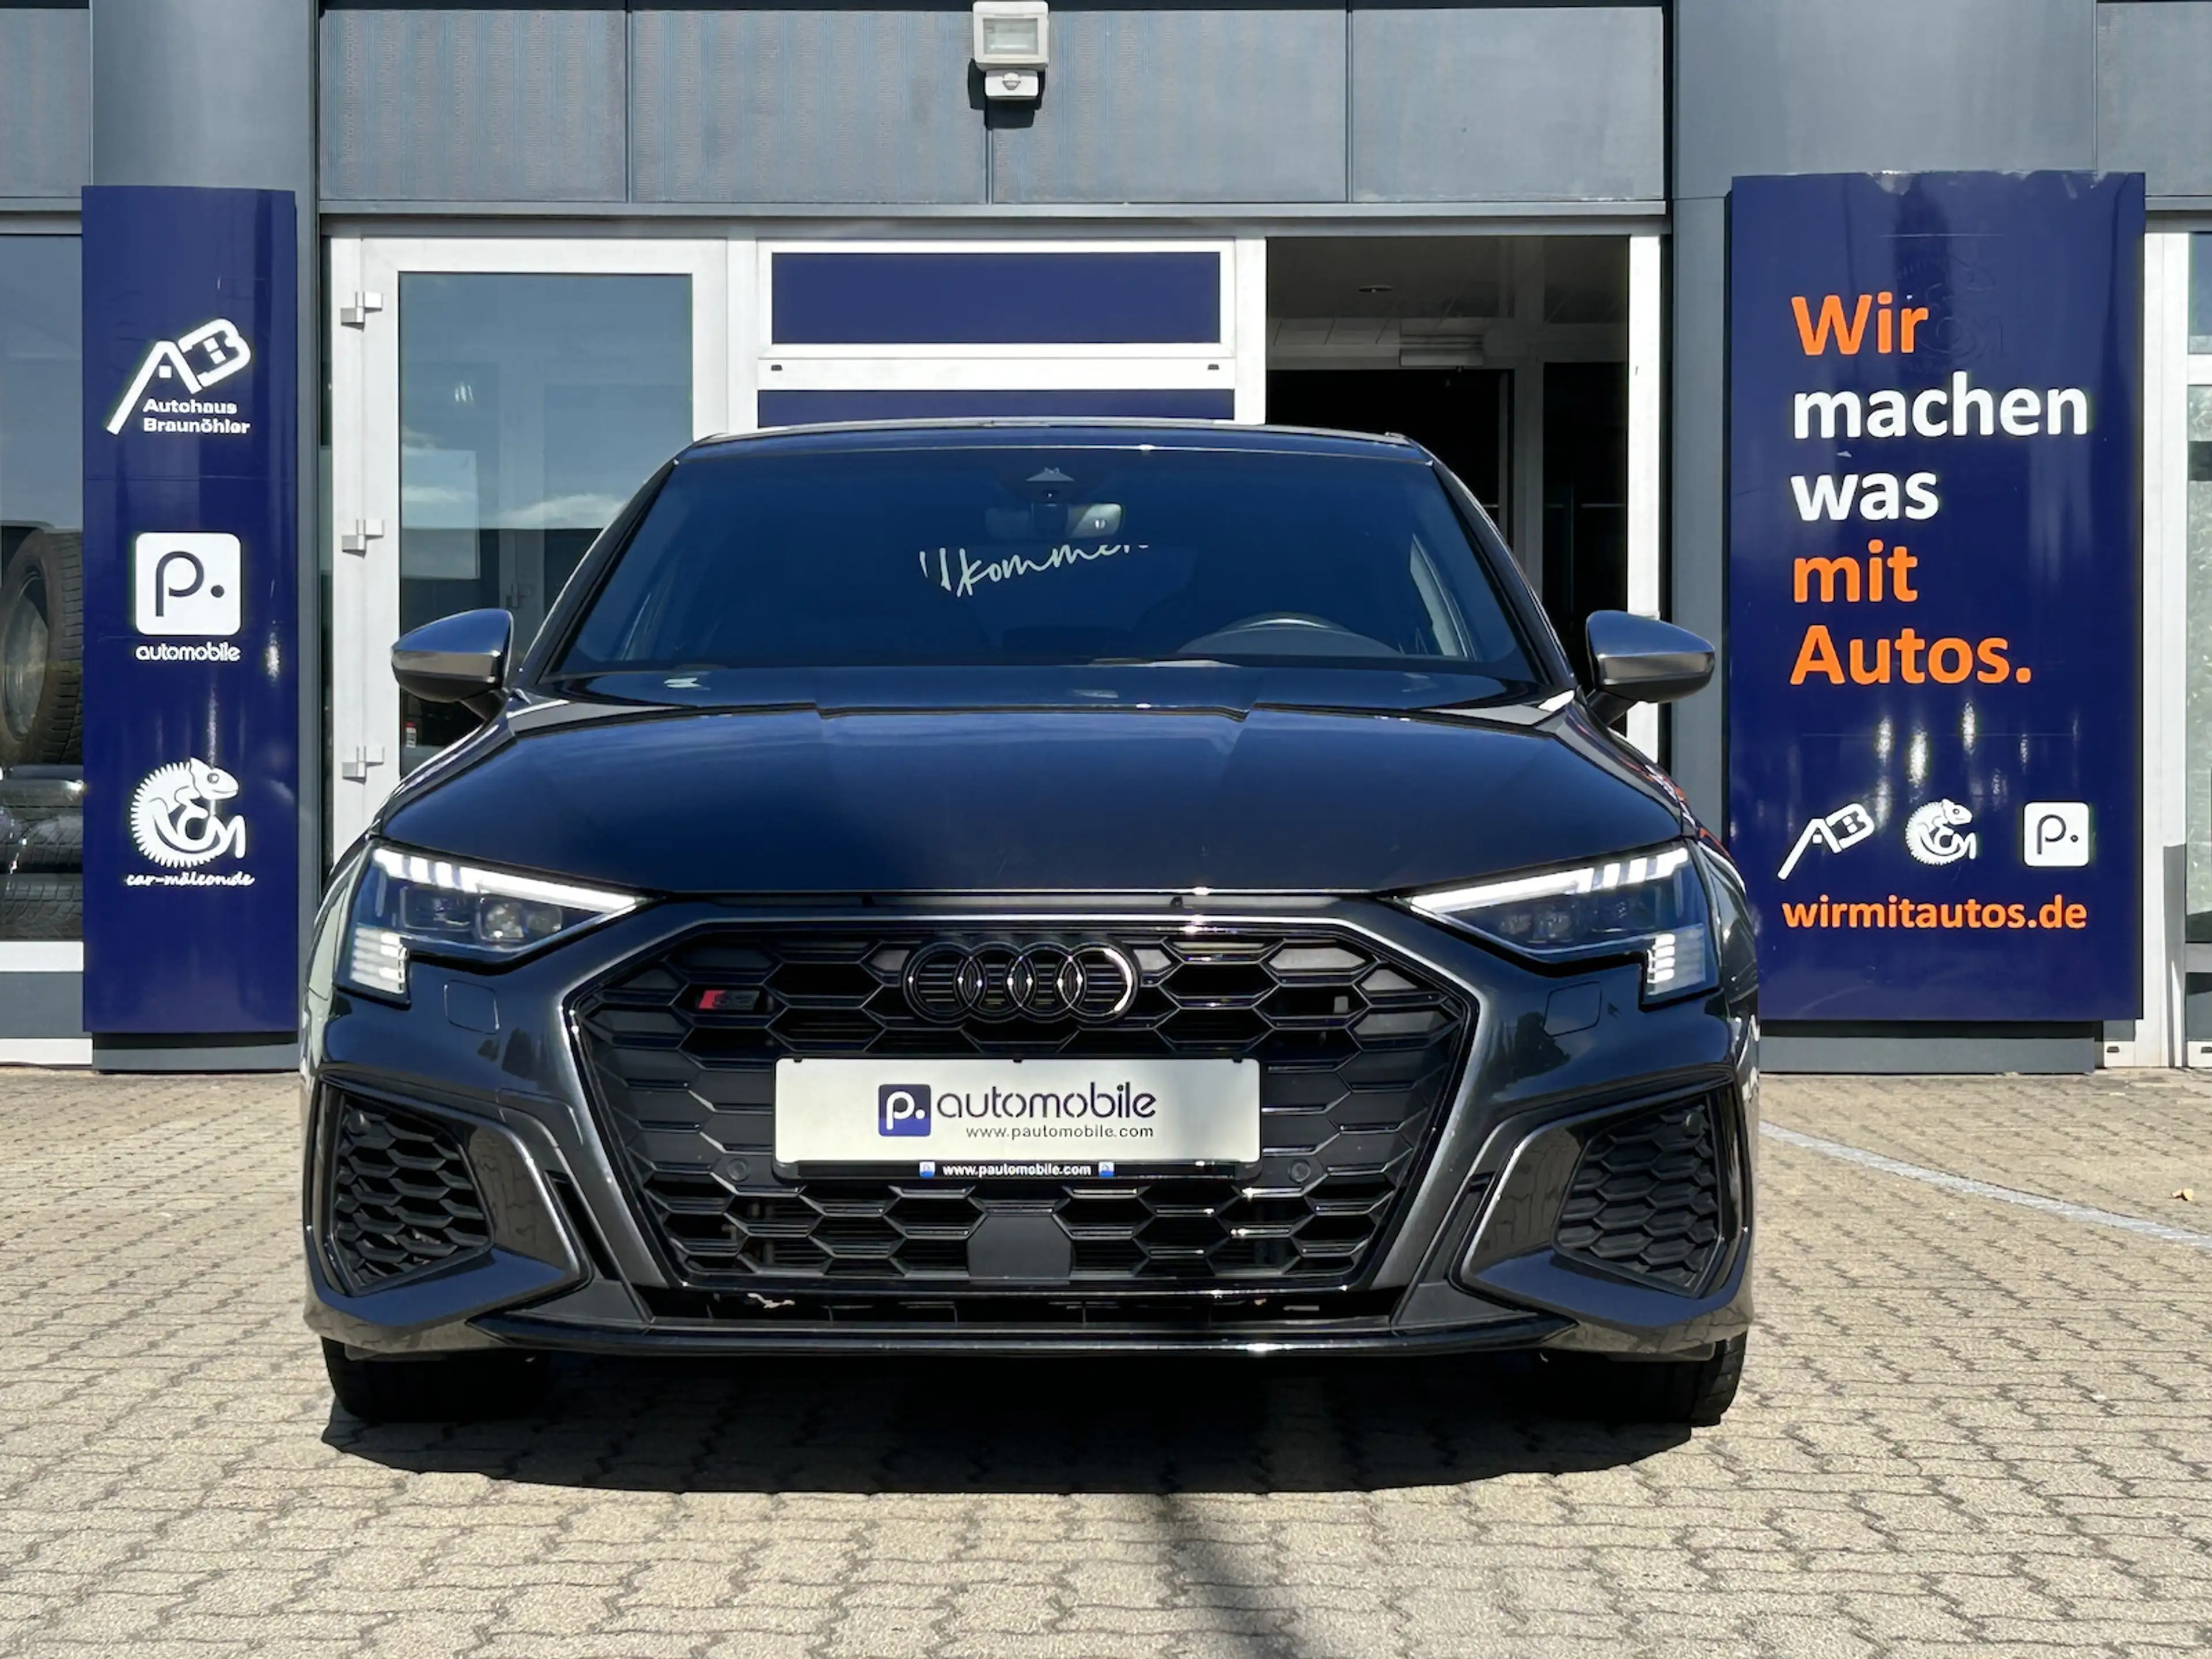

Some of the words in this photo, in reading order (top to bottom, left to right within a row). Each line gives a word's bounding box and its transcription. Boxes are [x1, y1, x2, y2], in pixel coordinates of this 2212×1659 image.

[1791, 291, 1929, 355] Wir
[143, 398, 237, 414] Autohaus
[1794, 371, 2088, 439] machen
[143, 417, 251, 434] Braunöhler
[1790, 472, 1939, 521] was
[1794, 539, 1918, 603] mit
[135, 641, 241, 661] automobile
[1790, 625, 2031, 685] Autos.
[1782, 894, 2086, 929] wirmitautos.de
[937, 1081, 1157, 1118] automobile
[966, 1124, 1154, 1141] www.pautomobile.com
[942, 1162, 1092, 1178] www.pautomobile.com
